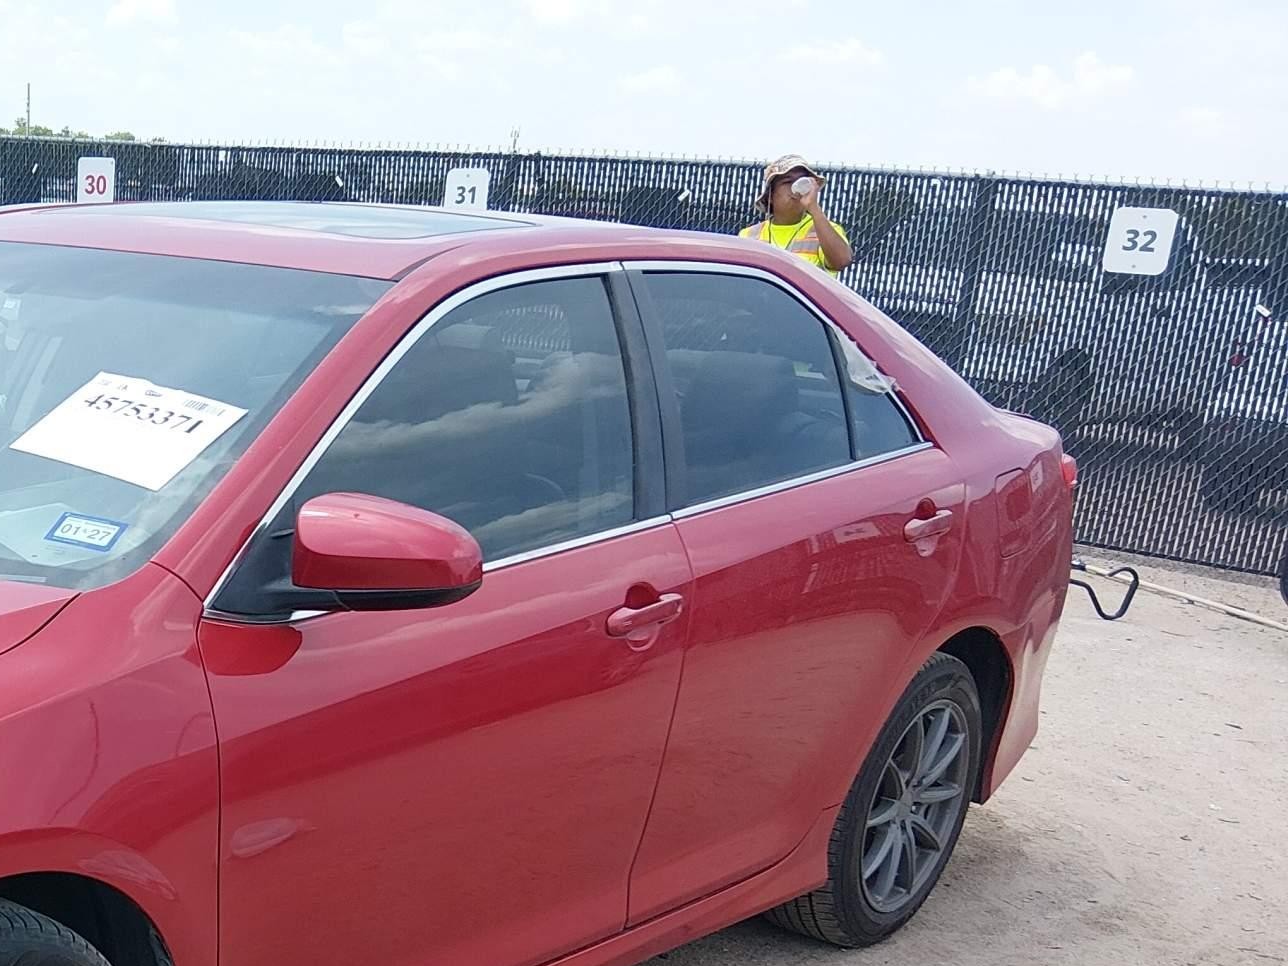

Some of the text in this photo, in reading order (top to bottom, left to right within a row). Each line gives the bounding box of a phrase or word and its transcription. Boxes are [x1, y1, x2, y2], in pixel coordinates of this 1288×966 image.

[84, 174, 107, 195] 30
[455, 185, 477, 204] 31
[1122, 228, 1158, 253] 32
[83, 393, 204, 434] 45753371
